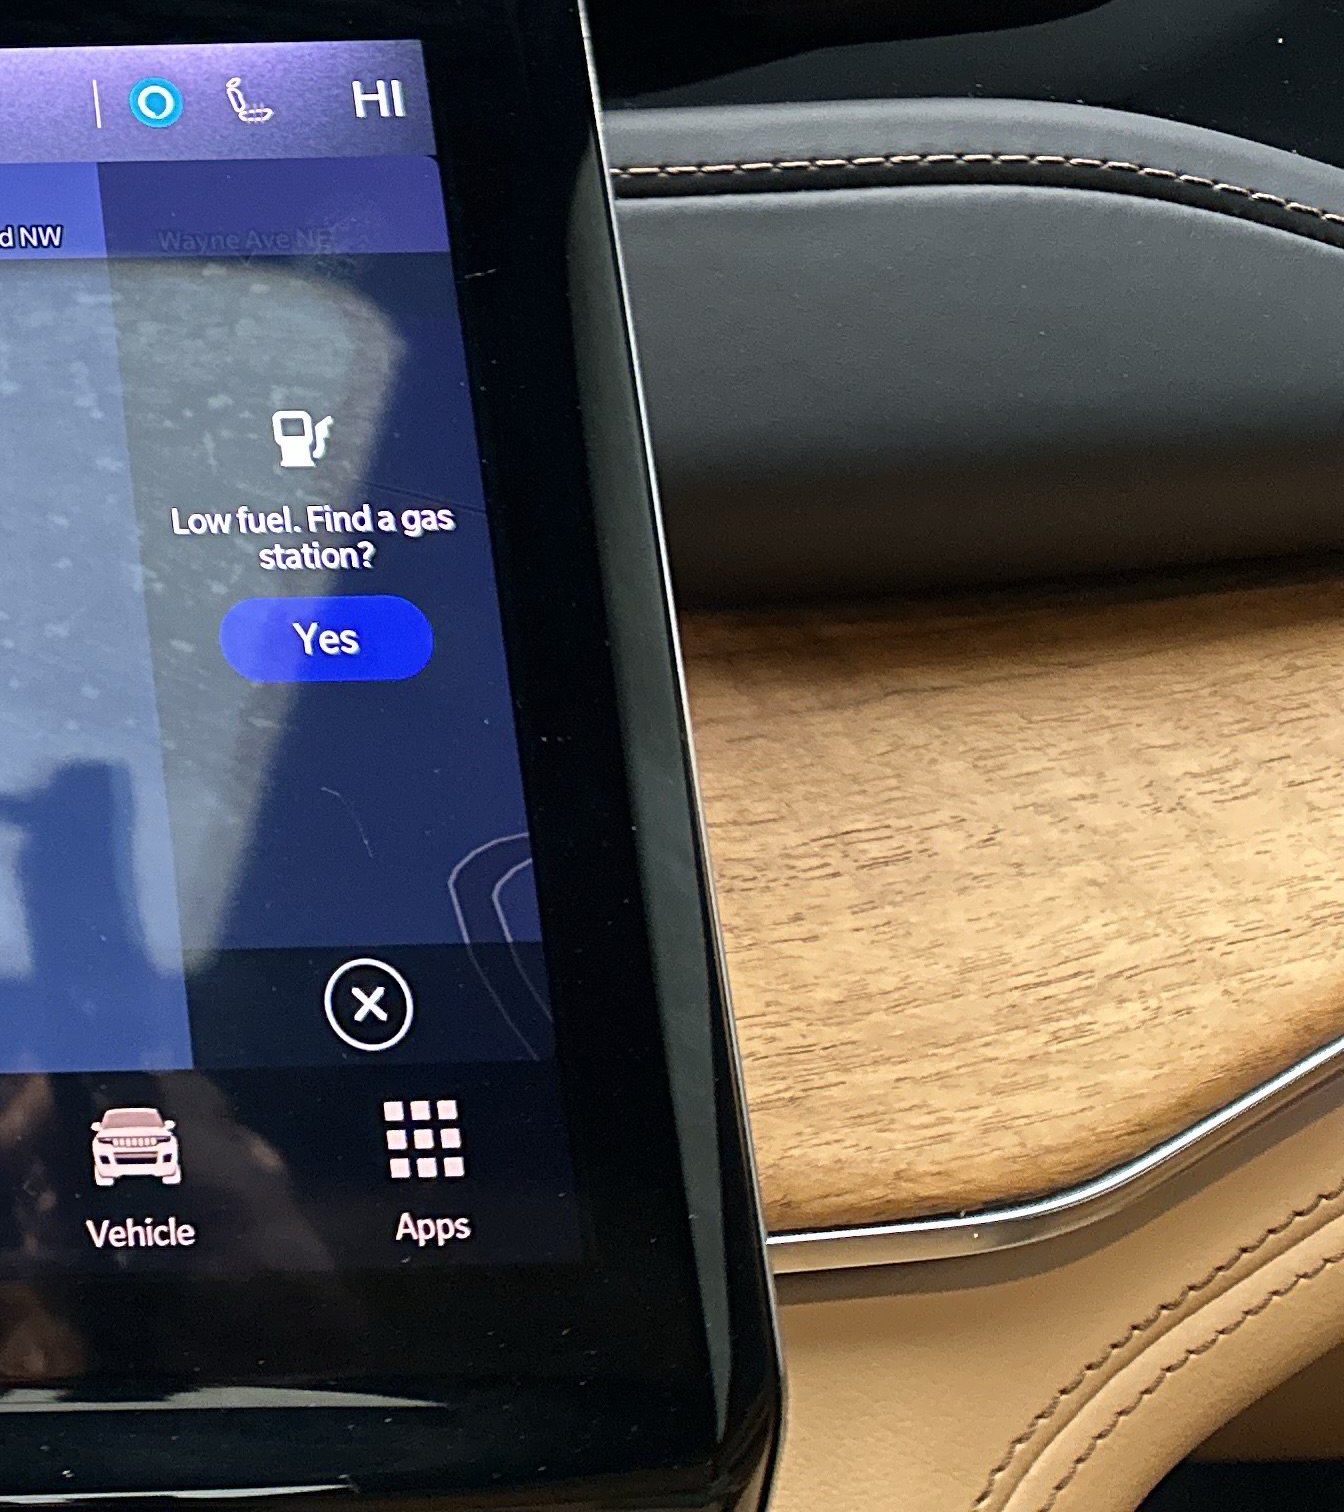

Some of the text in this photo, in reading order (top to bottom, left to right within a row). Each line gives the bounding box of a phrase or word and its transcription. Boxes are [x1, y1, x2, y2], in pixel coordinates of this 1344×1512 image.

[351, 79, 406, 118] HI
[19, 226, 61, 247] NW
[171, 503, 456, 538] Low fuel. Find a gas
[258, 540, 375, 571] station?
[291, 622, 360, 656] Yes
[85, 1216, 196, 1248] Vehicle
[395, 1212, 472, 1247] Apps
